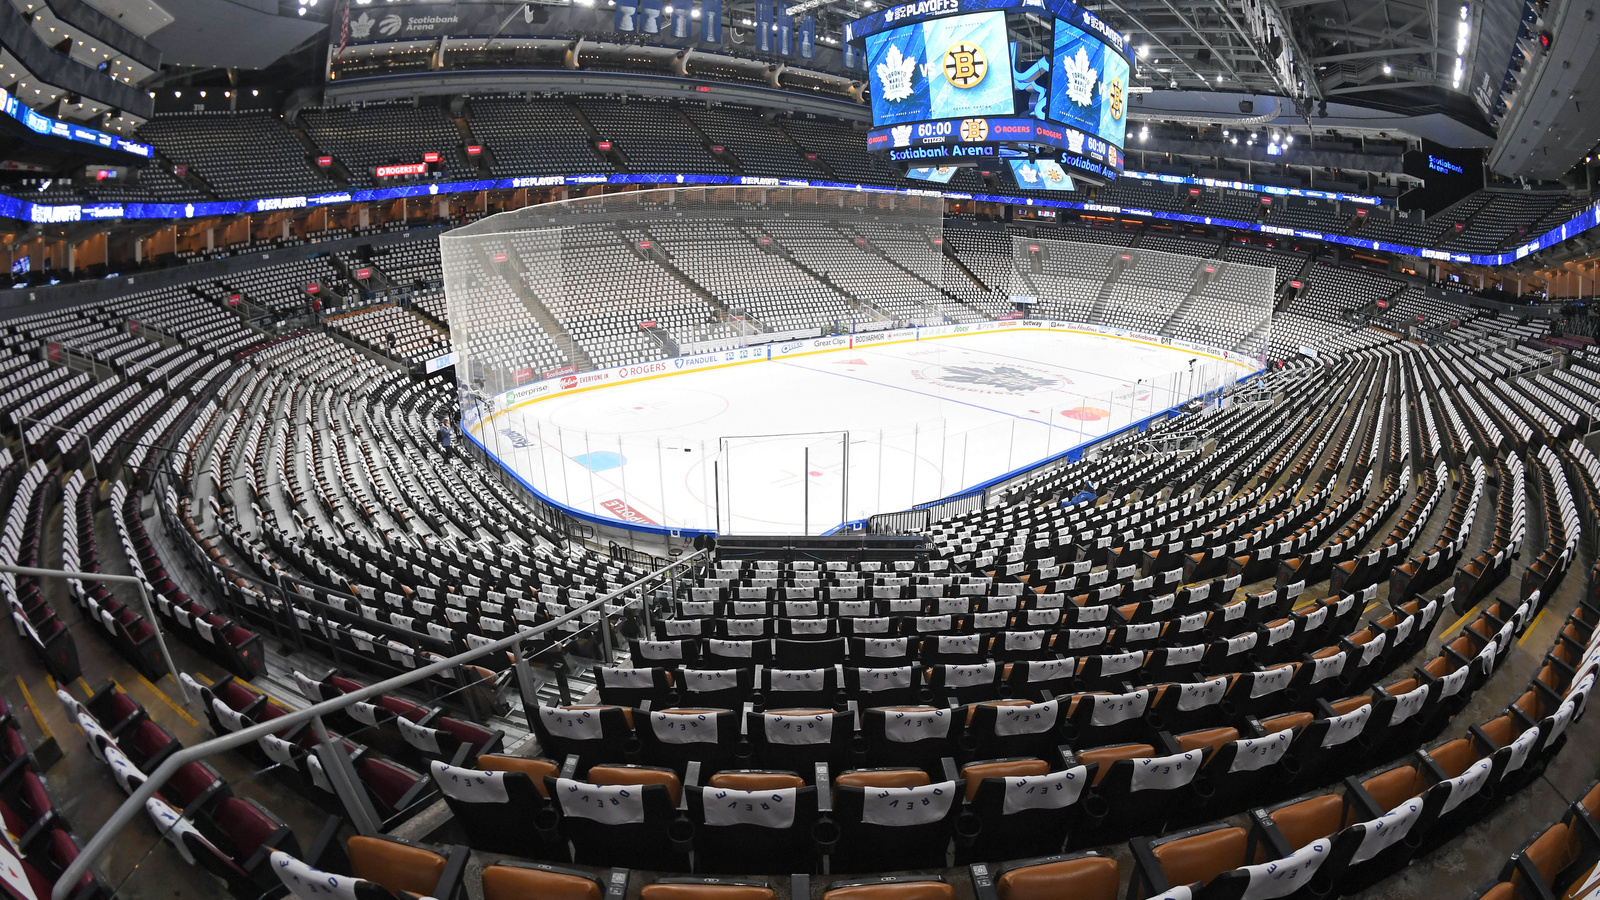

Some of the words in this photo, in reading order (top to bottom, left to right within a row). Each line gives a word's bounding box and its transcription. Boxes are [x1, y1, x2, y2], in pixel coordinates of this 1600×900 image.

[906, 0, 959, 17] PLAYOFFS
[407, 15, 459, 25] Scotiabank
[885, 71, 907, 80] TORONTO
[919, 62, 936, 78] VS
[917, 121, 952, 137] 60:00
[1002, 125, 1031, 133] ROGERS
[1042, 128, 1062, 140] ROGERS
[922, 136, 945, 144] CITIZEN
[1088, 136, 1106, 155] 60:00
[890, 145, 949, 161] Scotiabank
[952, 144, 993, 157] Arena
[1060, 152, 1102, 174] Scotiabank
[1101, 166, 1117, 180] Arena
[1428, 154, 1463, 174] Scotiabank
[1428, 161, 1449, 175] Arena
[385, 165, 413, 175] ROGERS
[530, 176, 565, 186] PLAYOFFS
[375, 290, 385, 298] IBM
[1022, 320, 1042, 328] betway
[1067, 322, 1077, 330] Tim
[1077, 323, 1097, 332] Hortons
[855, 333, 885, 344] BODYARMOR
[1129, 331, 1158, 342] Scotiabank
[1160, 337, 1172, 346] CAT
[813, 339, 830, 348] Great
[831, 337, 846, 347] Clips
[1191, 343, 1207, 352] Uber
[1206, 346, 1221, 355] Eats
[436, 355, 451, 369] IBM
[685, 356, 718, 366] FANDUEL
[630, 363, 666, 376] ROGERS
[579, 375, 600, 384] EVERYONE
[509, 384, 548, 400] enterprise
